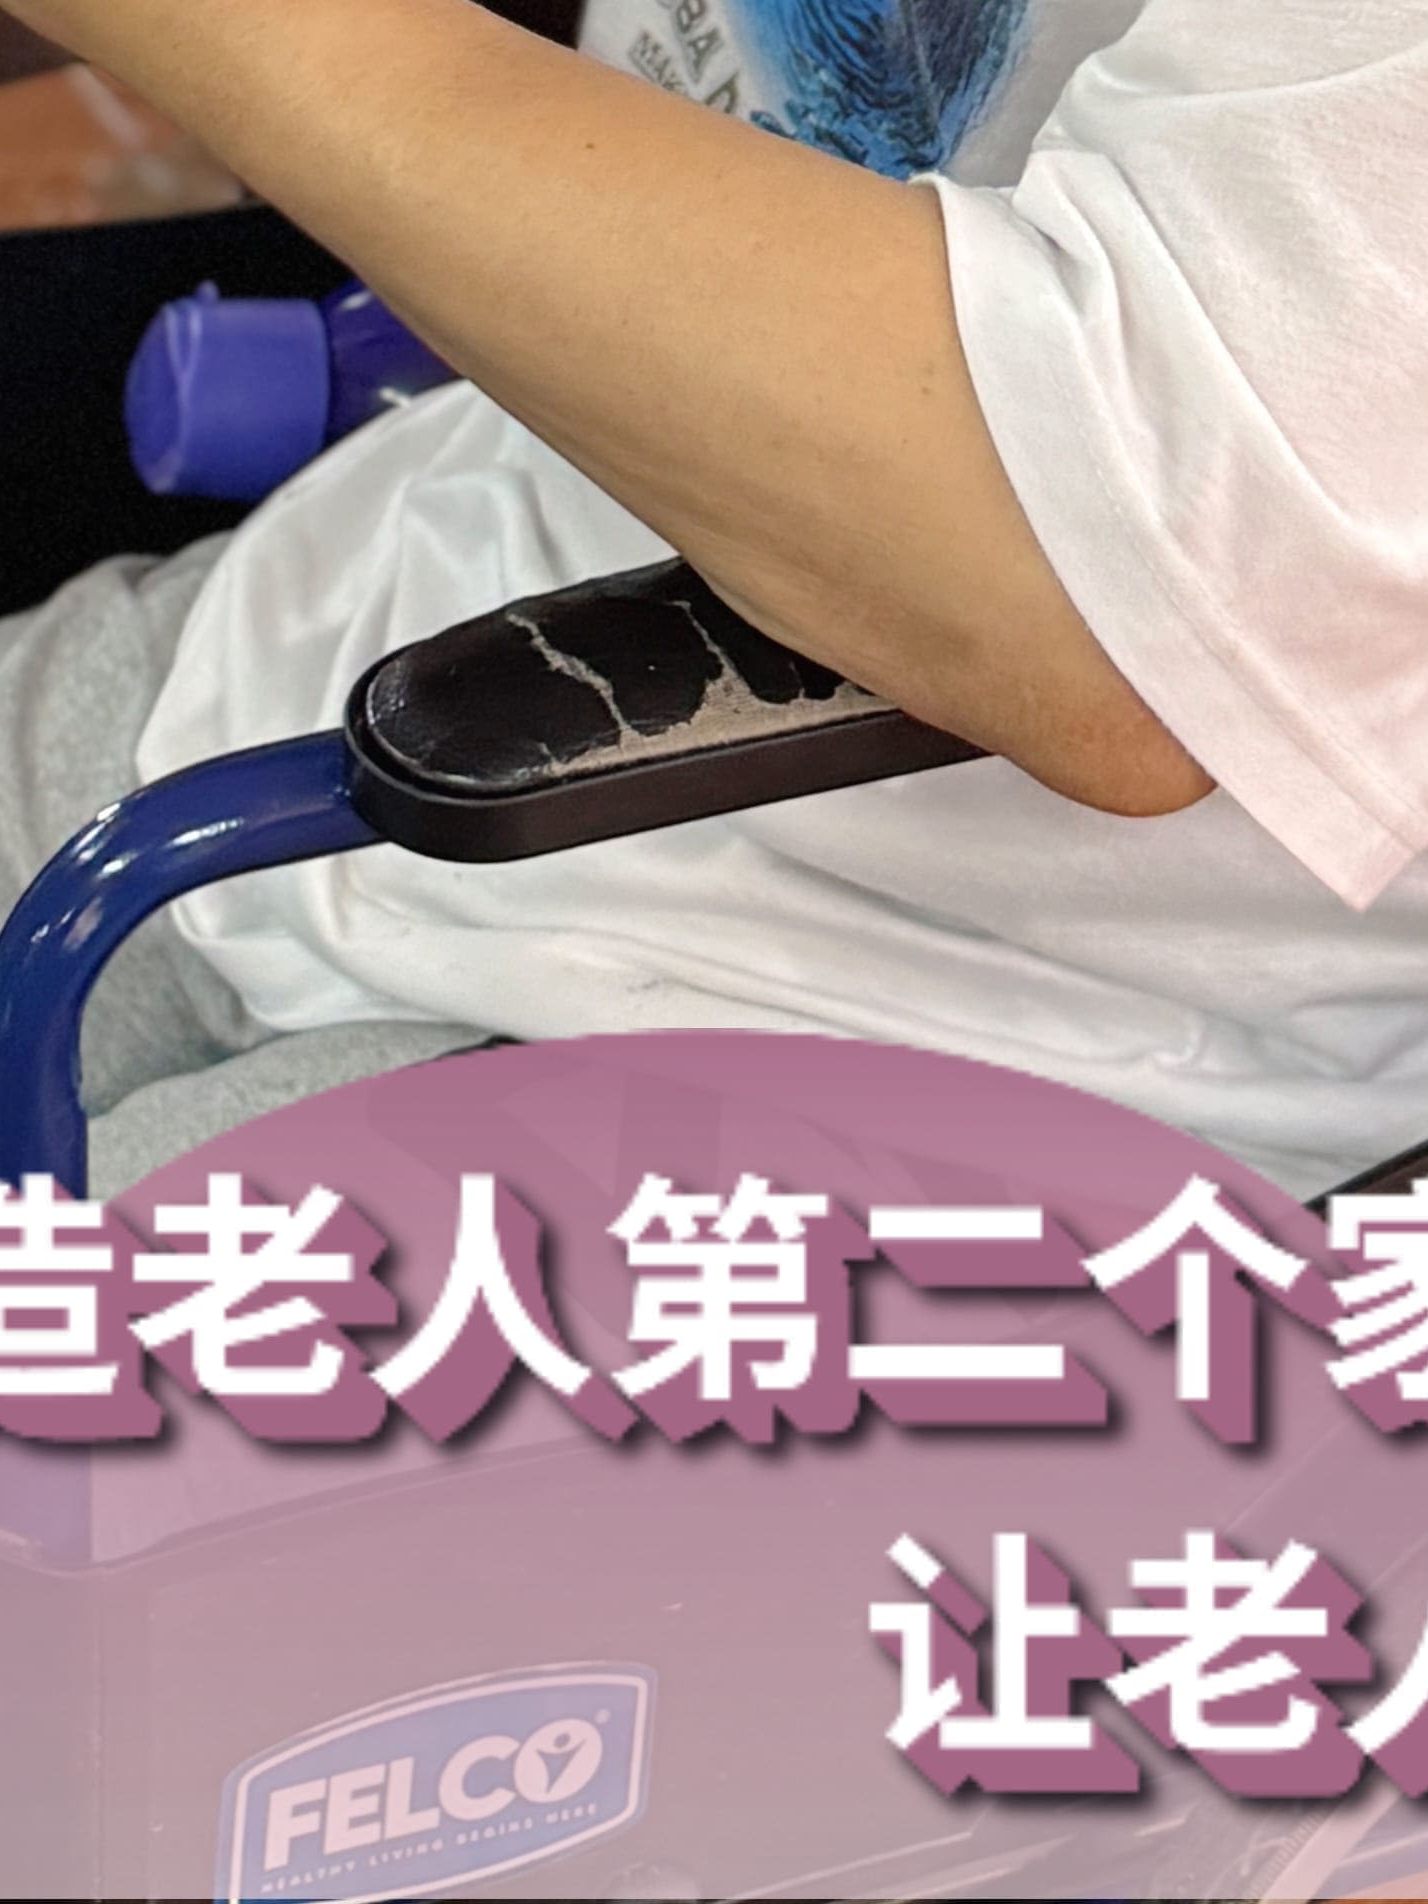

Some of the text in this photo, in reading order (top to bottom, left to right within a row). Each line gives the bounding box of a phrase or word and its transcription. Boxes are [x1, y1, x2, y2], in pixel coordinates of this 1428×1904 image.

[260, 1802, 598, 1894] HEALTHY LIVING BEGINS HERE
[263, 1717, 604, 1871] FELCO
